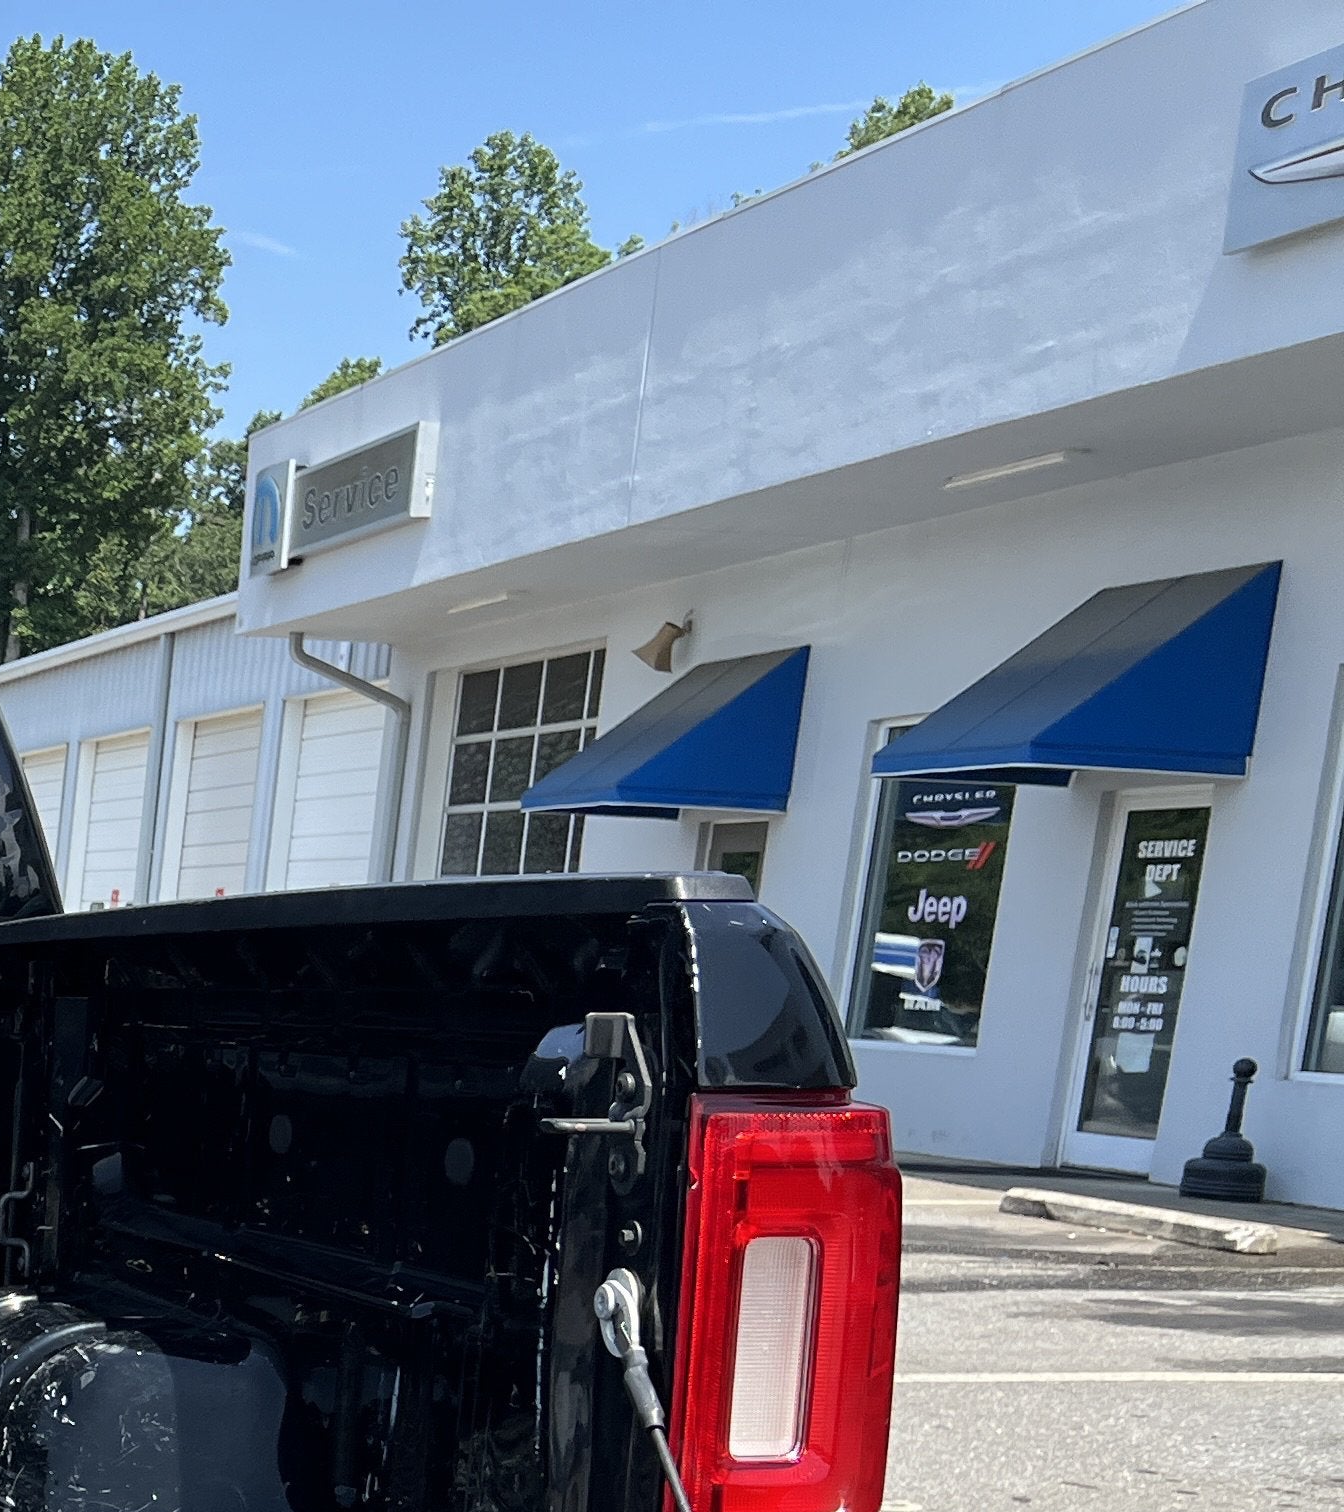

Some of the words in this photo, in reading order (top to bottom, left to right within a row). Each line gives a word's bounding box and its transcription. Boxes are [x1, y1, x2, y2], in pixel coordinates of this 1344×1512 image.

[302, 465, 401, 530] Service
[896, 848, 981, 863] DODGE
[1138, 839, 1196, 858] SERVICE
[1145, 864, 1181, 881] DEPT
[907, 888, 967, 929] Jeep
[1120, 975, 1168, 994] HOURS
